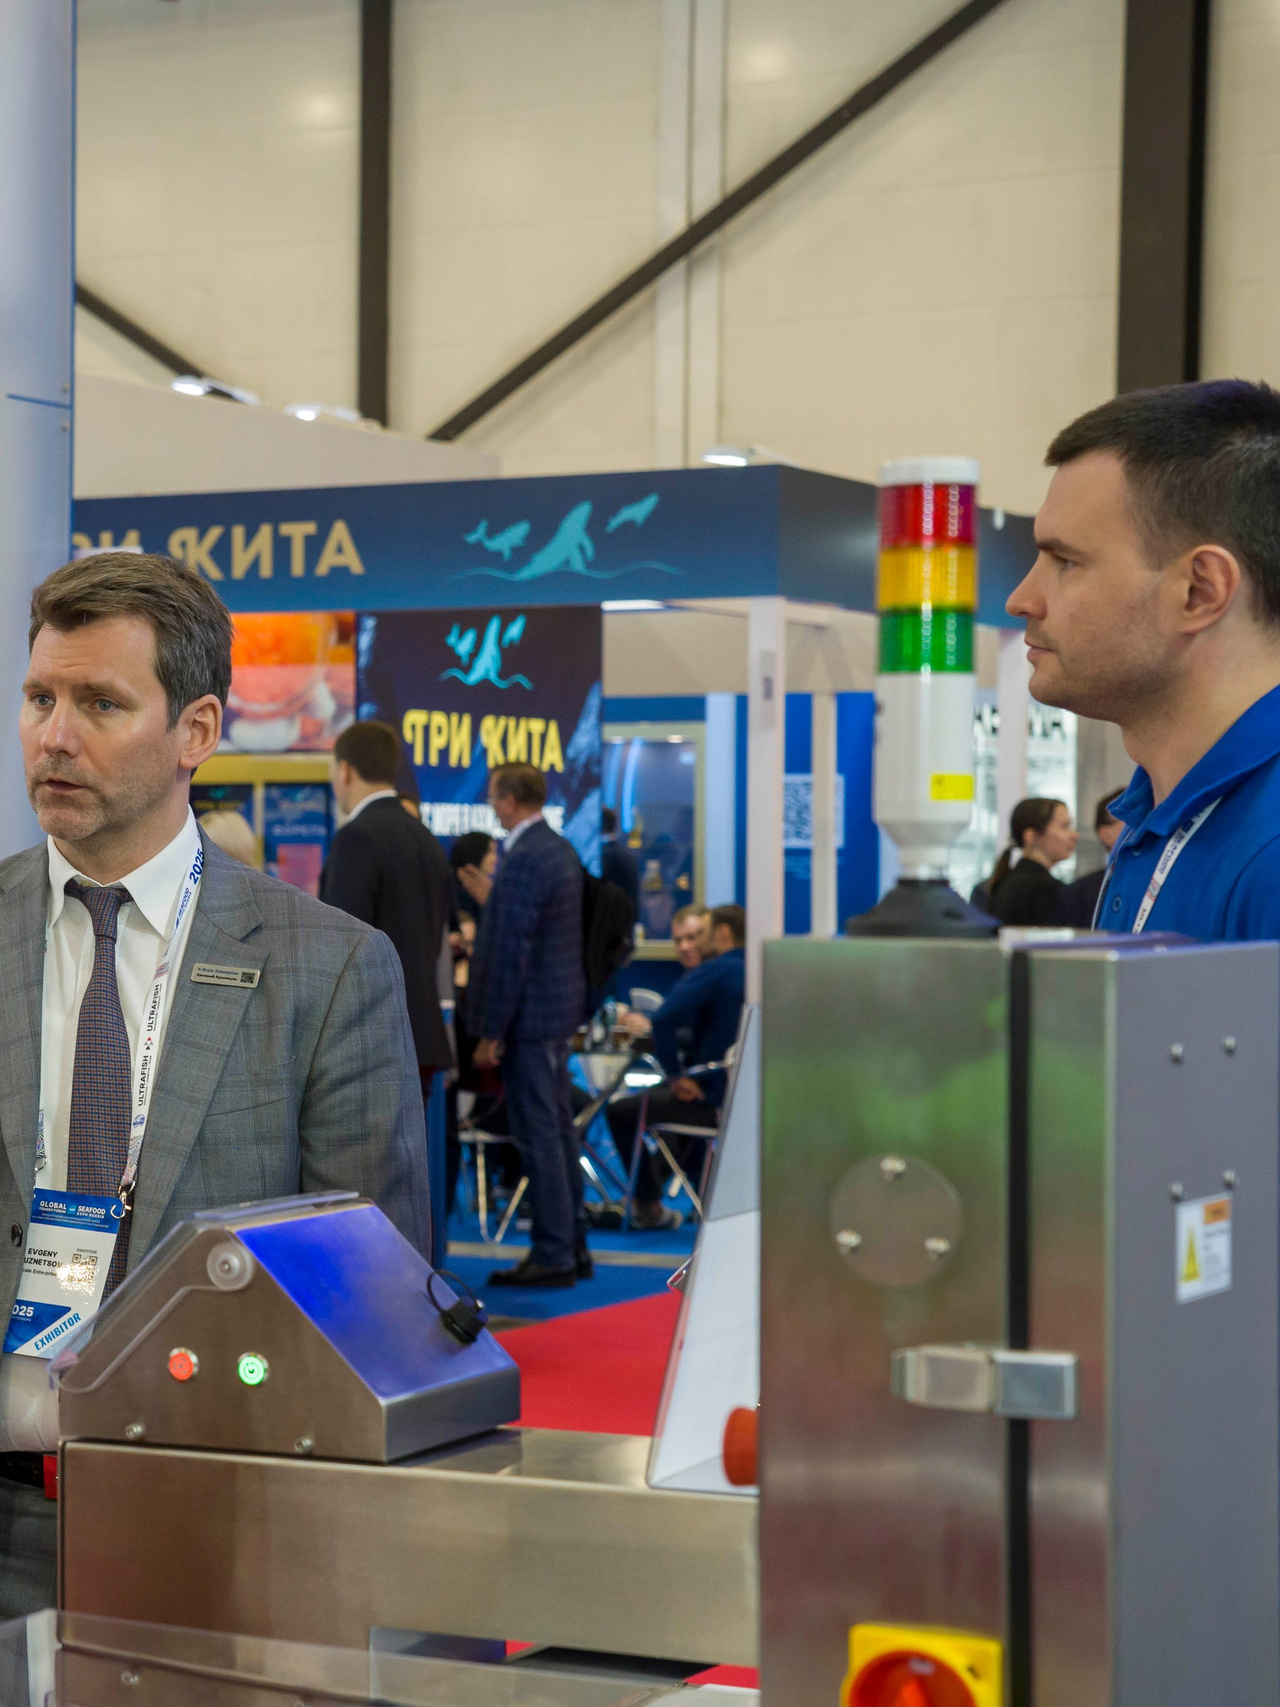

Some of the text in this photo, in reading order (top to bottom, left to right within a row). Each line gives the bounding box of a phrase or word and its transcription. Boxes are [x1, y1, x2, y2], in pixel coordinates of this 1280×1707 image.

[168, 519, 366, 581] КИТА
[402, 709, 565, 773] ТРИ КИТА
[189, 848, 205, 885] 2025
[147, 984, 160, 1032] ULTRAFISH
[138, 1055, 149, 1107] ULTRAFISH
[39, 1200, 67, 1210] GLOBAL
[77, 1205, 106, 1215] SEAFOOD
[23, 1257, 63, 1268] UZNETSOV
[28, 1248, 58, 1258] EVGENY
[12, 1305, 35, 1317] 025
[34, 1312, 82, 1351] EXHIBITOR
